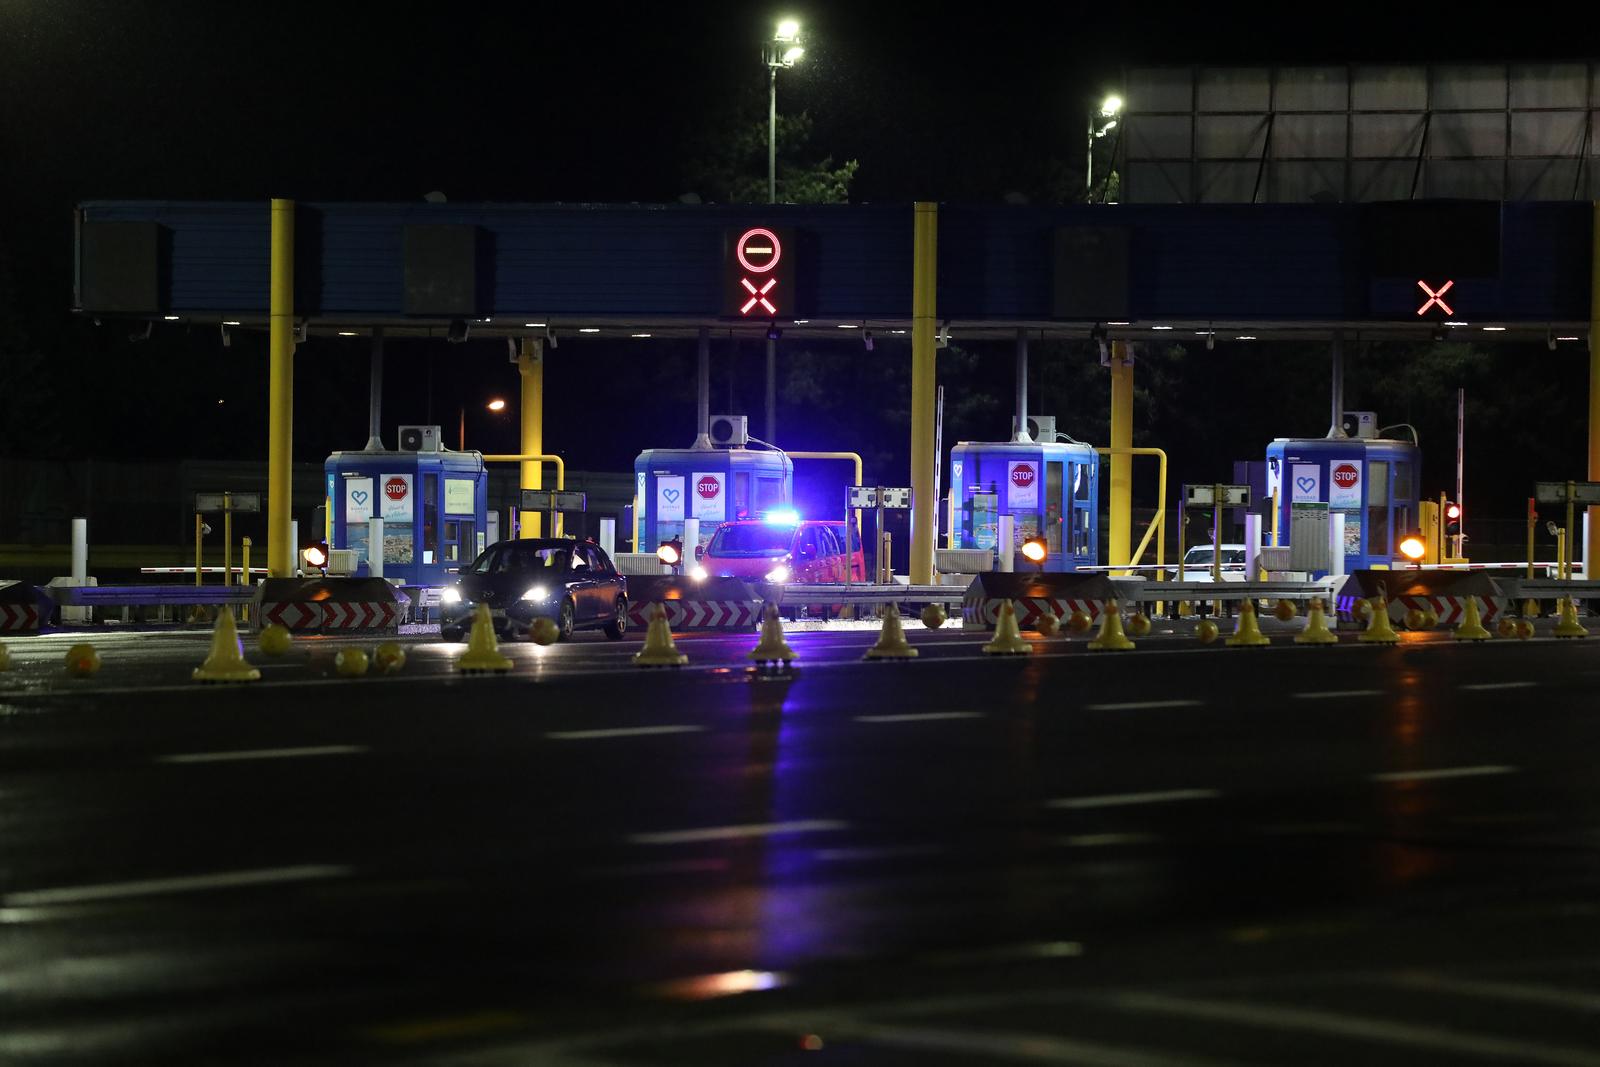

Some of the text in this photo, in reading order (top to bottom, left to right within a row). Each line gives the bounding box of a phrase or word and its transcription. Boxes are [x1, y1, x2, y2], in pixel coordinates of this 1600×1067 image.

[1013, 471, 1033, 480] STOP
[1335, 471, 1357, 480] STOP
[386, 484, 406, 493] STOP
[699, 483, 718, 492] STOP
